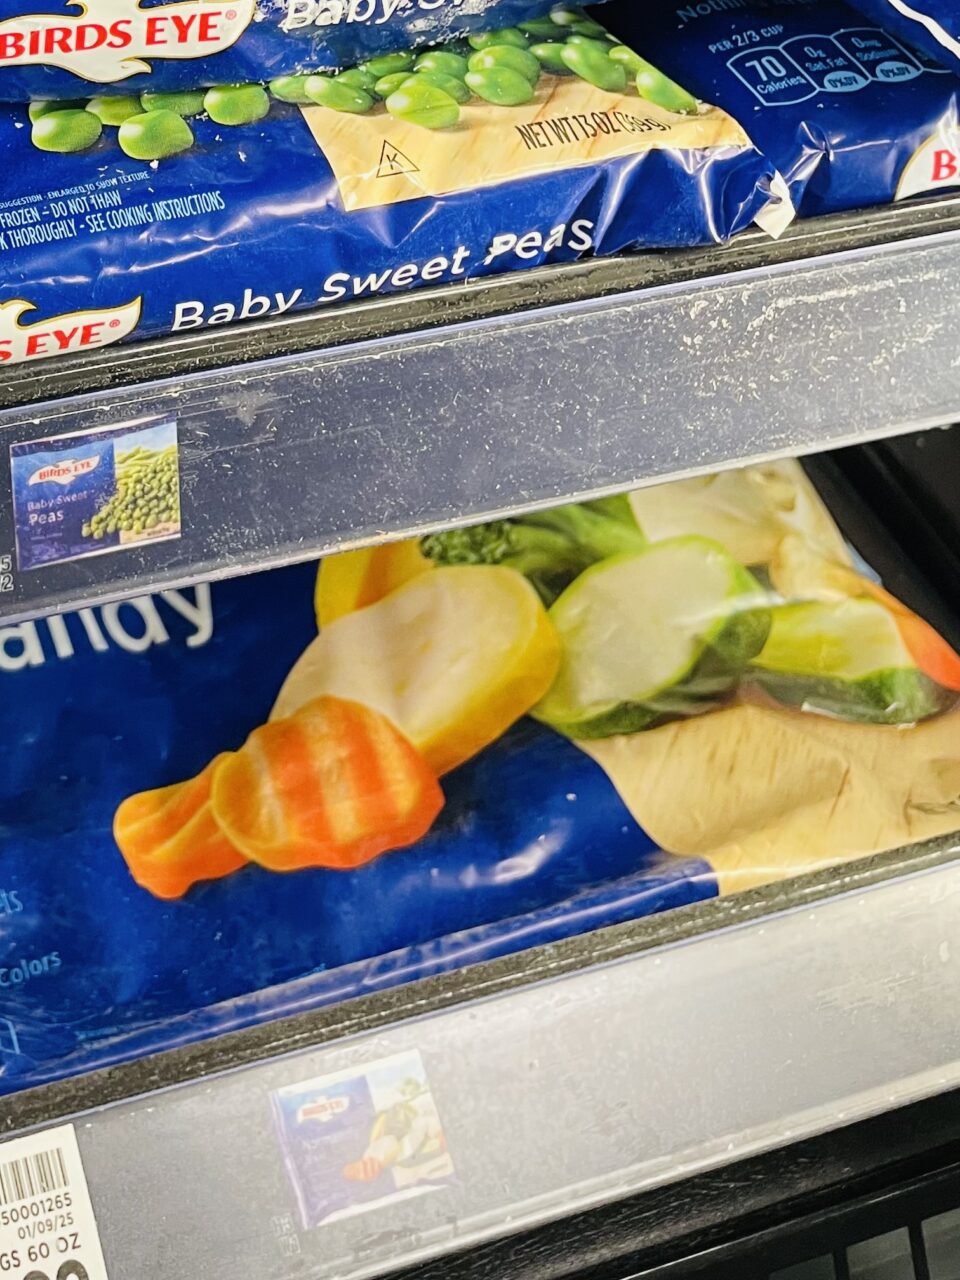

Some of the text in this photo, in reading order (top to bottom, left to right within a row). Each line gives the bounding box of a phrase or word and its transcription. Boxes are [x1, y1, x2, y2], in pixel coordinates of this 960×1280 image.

[708, 23, 786, 55] PER 2/3 CUP
[745, 55, 788, 83] 70
[756, 74, 808, 96] Calories
[50, 202, 67, 219] DO
[68, 195, 92, 215] NOT
[90, 189, 122, 210] THAW
[7, 218, 79, 250] THOROUGHLY
[86, 214, 107, 234] SEE
[105, 203, 155, 231] COOKING
[152, 190, 227, 222] INSTRUCTIONS
[171, 218, 598, 334] Baby Sweet Peas
[29, 510, 65, 526] Peas
[17, 1214, 75, 1240] 01/09/25
[28, 1241, 51, 1263] 60
[56, 1232, 82, 1254] OZ
